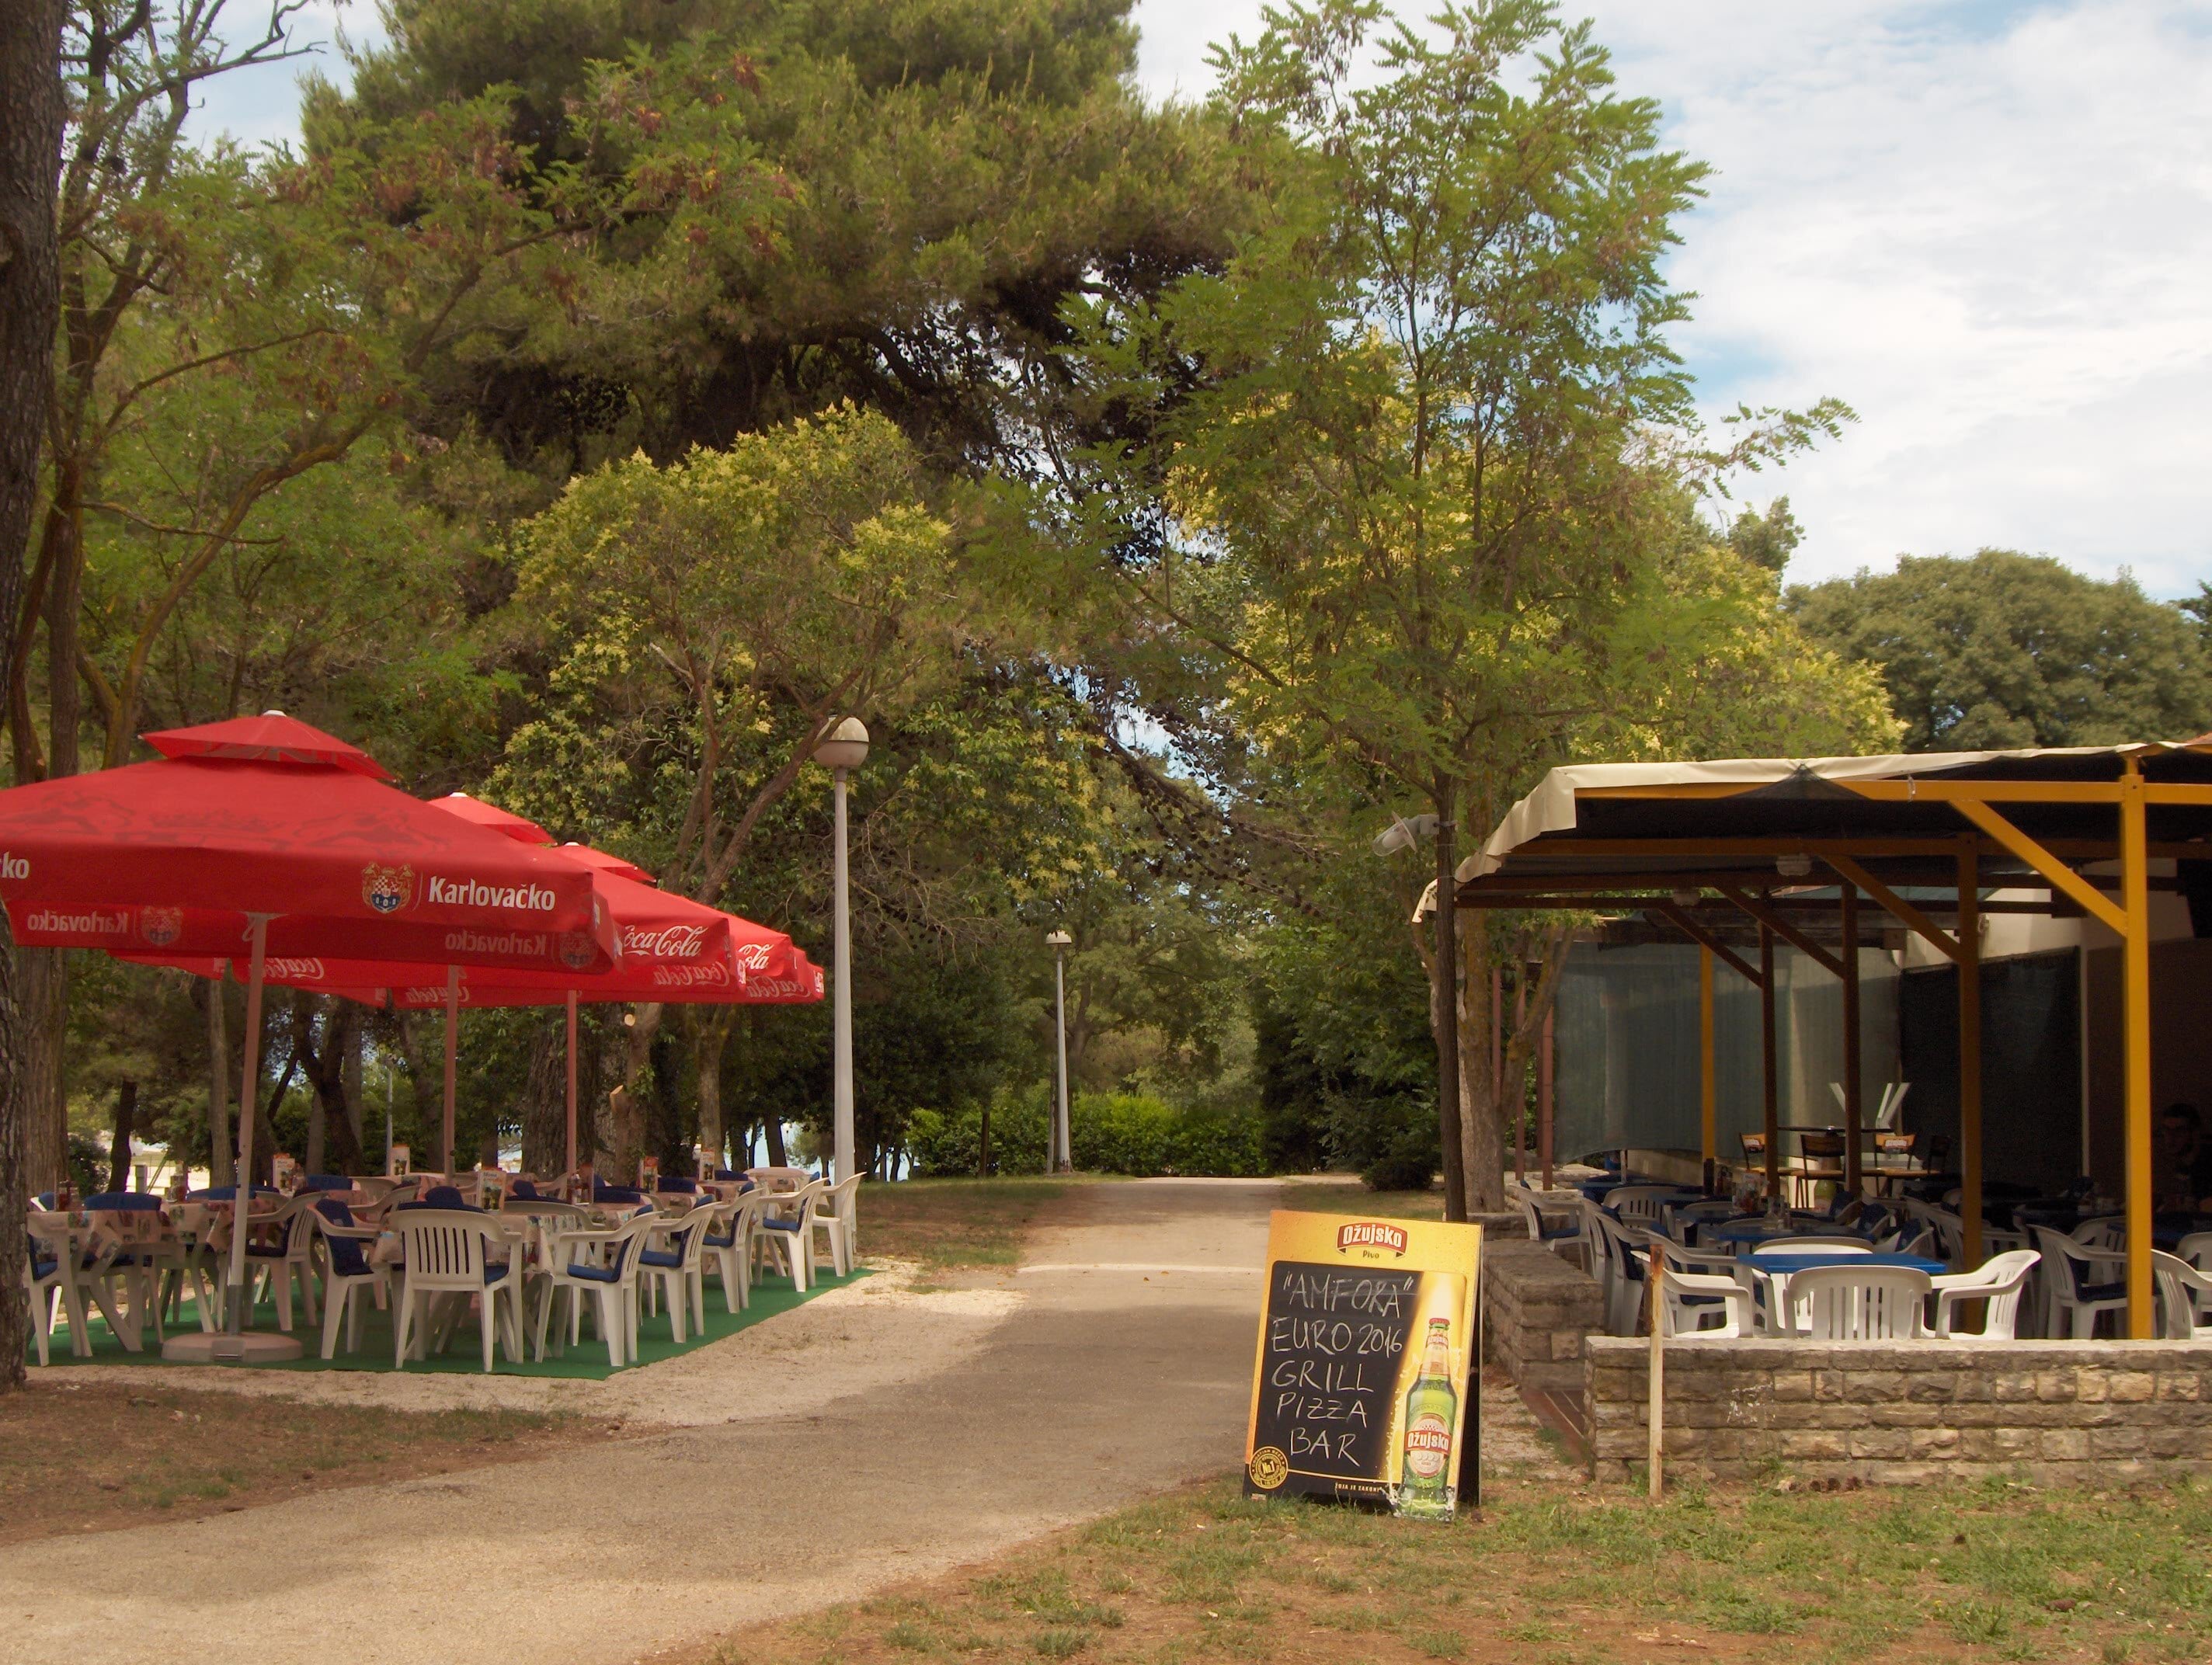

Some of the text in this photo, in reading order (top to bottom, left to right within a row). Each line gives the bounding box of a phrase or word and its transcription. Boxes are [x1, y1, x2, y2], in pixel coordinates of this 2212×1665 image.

[0, 851, 30, 879] ko
[428, 875, 556, 911] Karlovačko
[1342, 1224, 1403, 1248] Ožujsko
[1362, 1250, 1380, 1259] Pivo
[1271, 1316, 1403, 1359] EURO 2016
[1271, 1360, 1374, 1393] GRILL
[1276, 1392, 1368, 1428] PIZZA
[1289, 1427, 1361, 1467] BAR
[1407, 1431, 1450, 1451] Ožujsko
